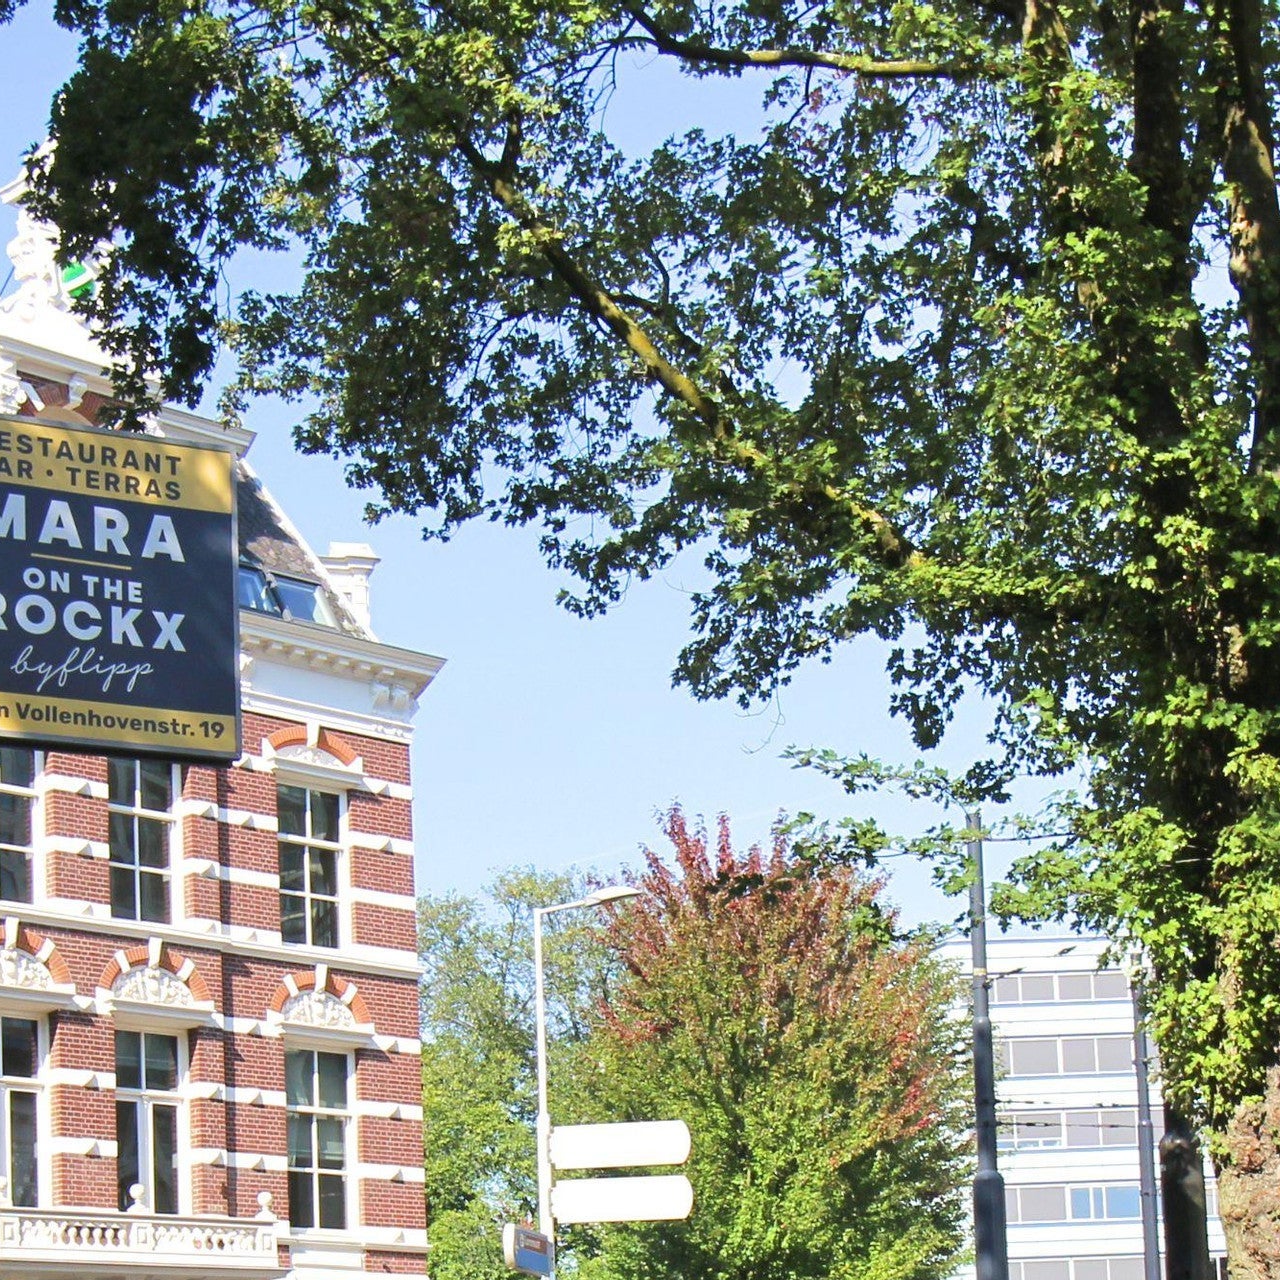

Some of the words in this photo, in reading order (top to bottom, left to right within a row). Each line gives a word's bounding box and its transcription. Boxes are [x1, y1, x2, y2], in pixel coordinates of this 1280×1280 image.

[66, 466, 182, 501] TERRAS
[22, 567, 70, 593] ON
[82, 575, 143, 603] THE
[15, 702, 195, 737] Vollenhovenstr.
[199, 720, 225, 739] 19
